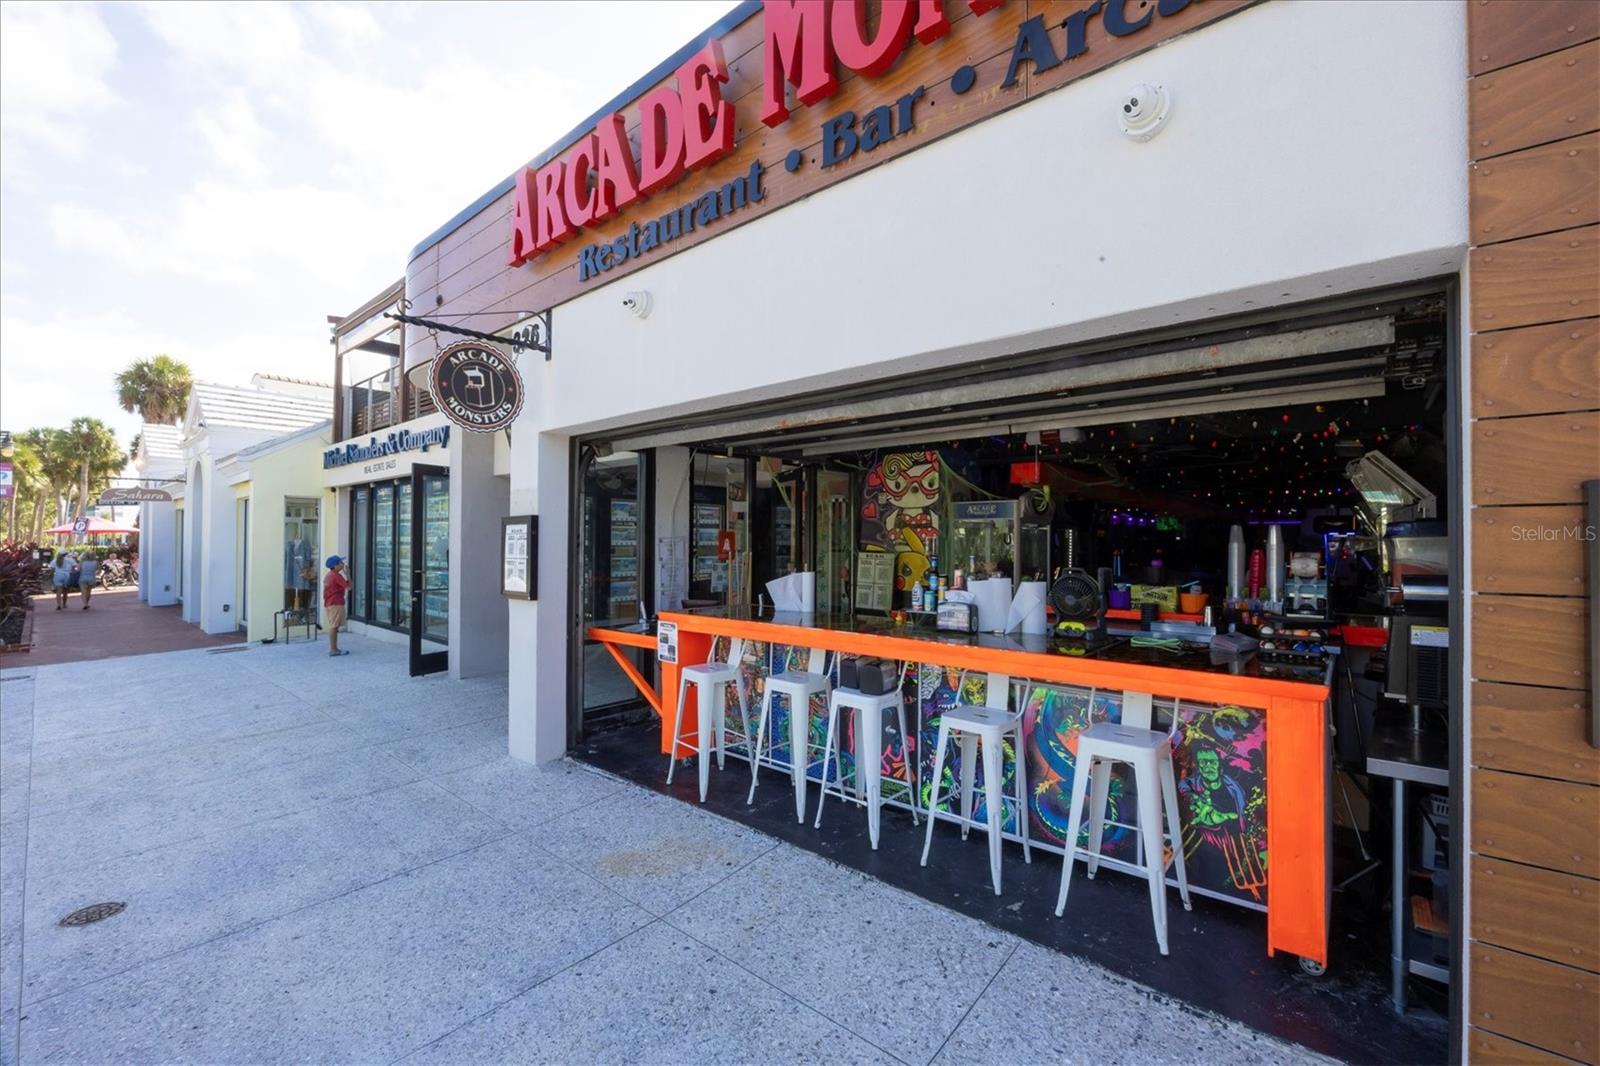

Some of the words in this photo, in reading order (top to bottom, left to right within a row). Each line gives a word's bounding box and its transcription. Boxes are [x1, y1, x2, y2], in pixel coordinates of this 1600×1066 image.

[508, 38, 737, 269] ARCADE
[578, 157, 767, 283] Restaurant
[821, 84, 925, 170] Bar
[1000, 0, 1198, 90] Arc
[449, 349, 508, 374] ARCADE
[446, 396, 513, 424] MONSTERS
[397, 426, 450, 452] Company
[112, 489, 164, 501] Sahara
